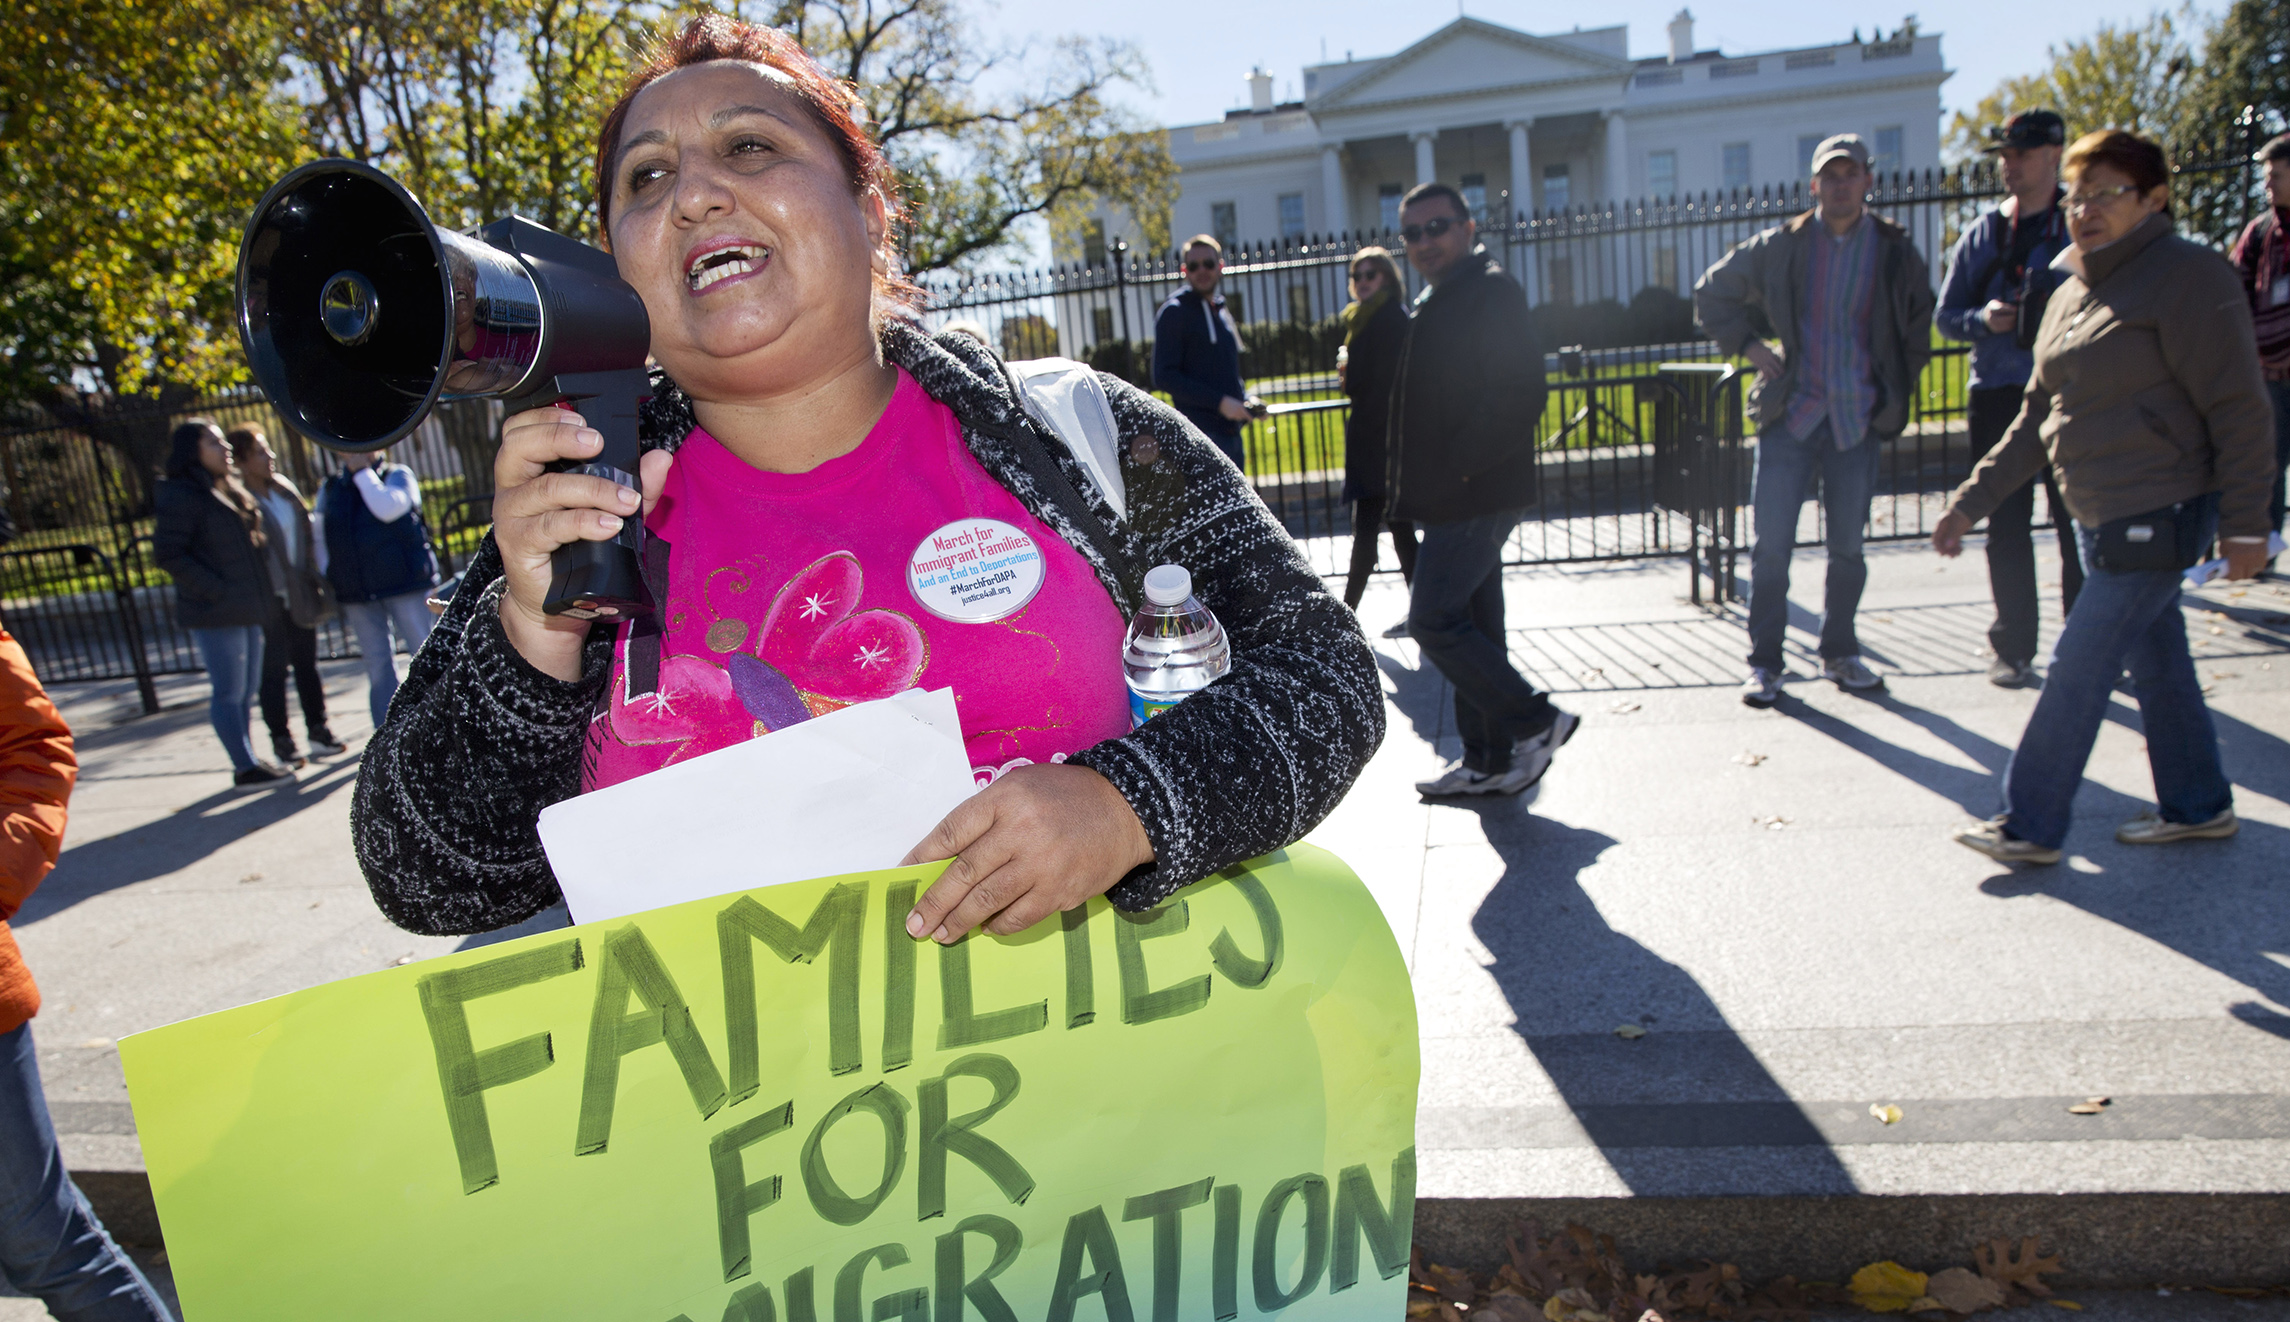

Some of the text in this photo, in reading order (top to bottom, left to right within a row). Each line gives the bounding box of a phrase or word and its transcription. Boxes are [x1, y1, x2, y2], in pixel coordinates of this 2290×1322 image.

[912, 536, 1031, 575] Immigrant Families
[932, 527, 994, 552] March for
[918, 551, 1038, 589] And an End to Deportations
[950, 570, 1017, 595] #MarchForDAPA
[961, 586, 1012, 606] justice4all.org
[416, 850, 1287, 1195] FAMILIES
[710, 1053, 1036, 1283] FOR
